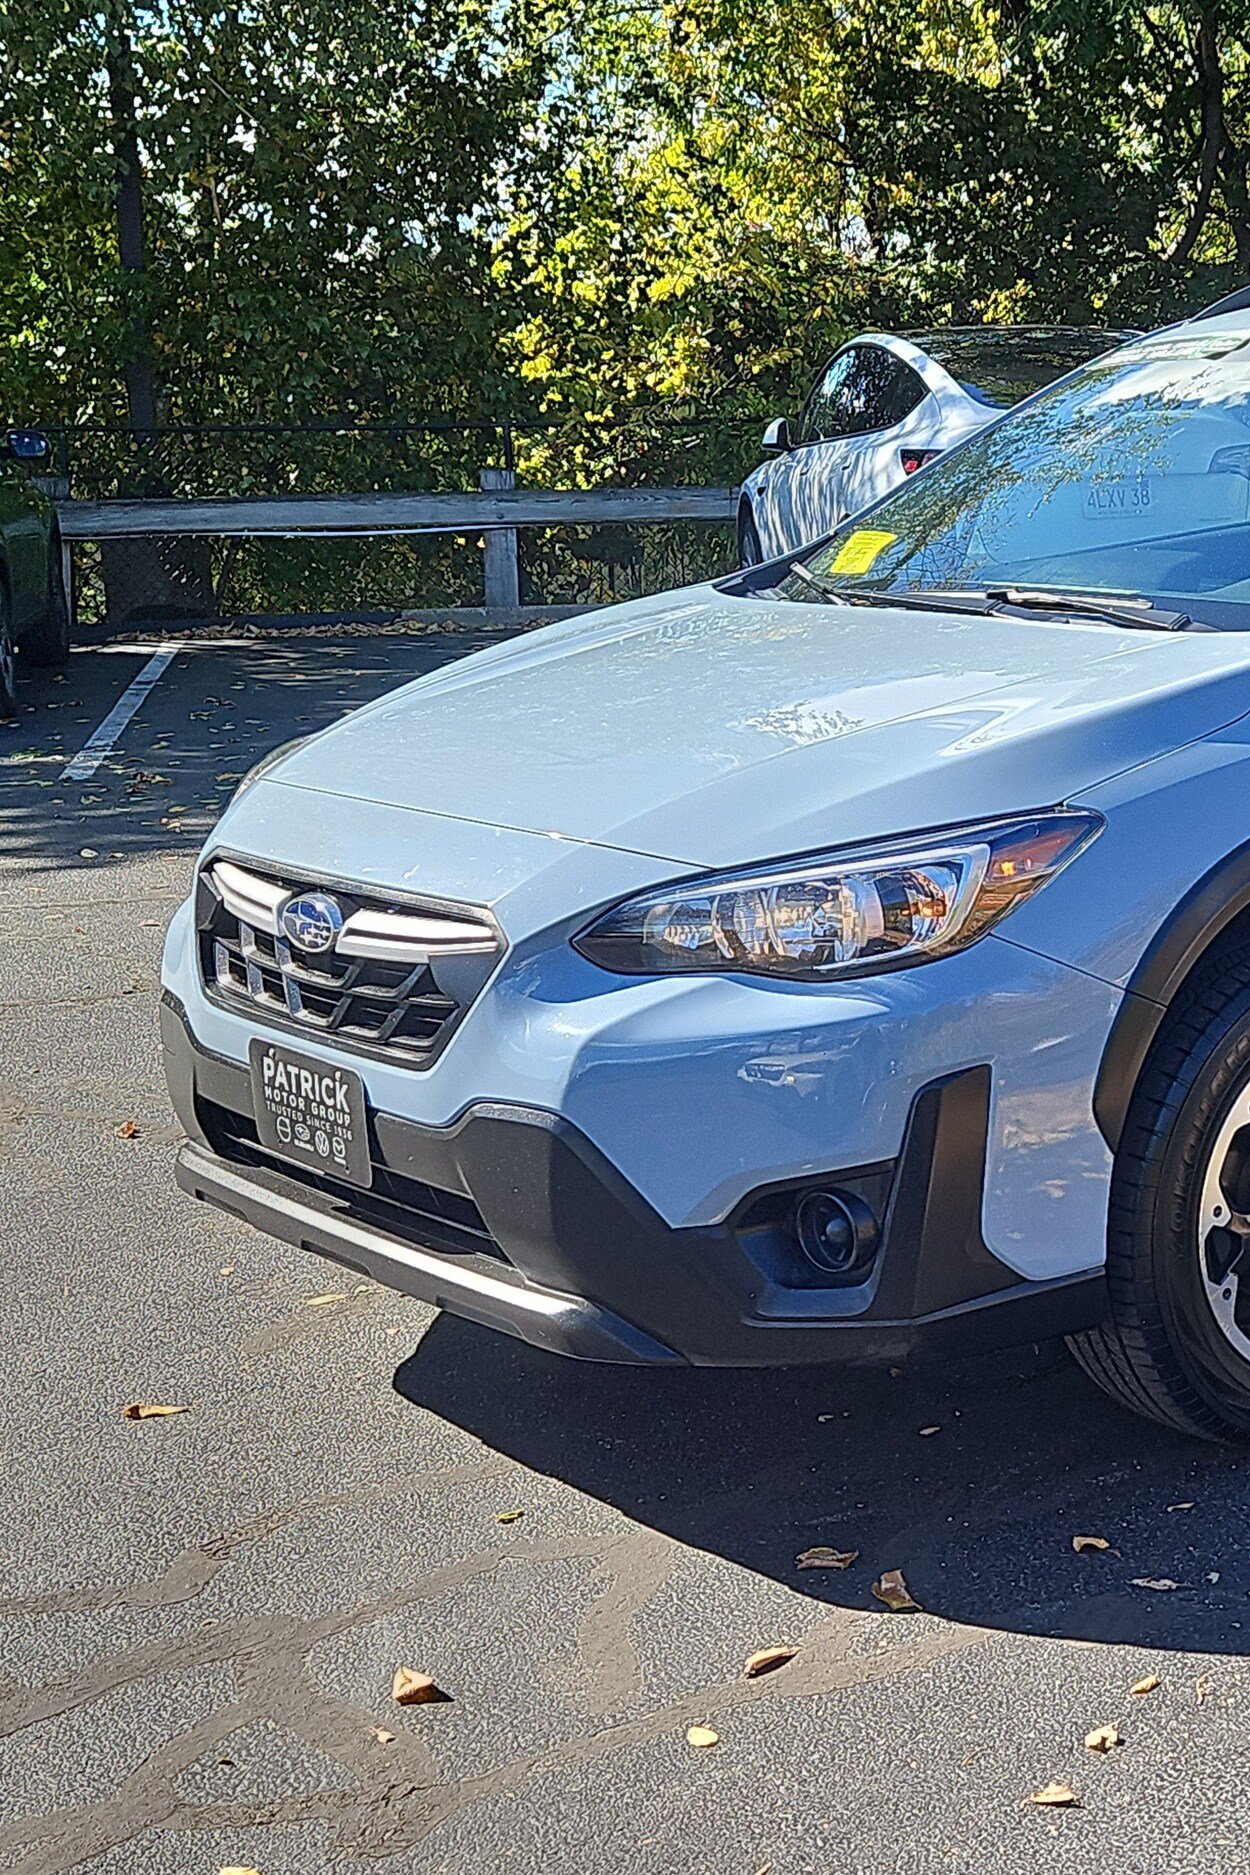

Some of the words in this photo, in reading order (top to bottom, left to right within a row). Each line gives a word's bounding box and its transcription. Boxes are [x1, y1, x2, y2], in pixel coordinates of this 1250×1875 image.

[1131, 488, 1151, 507] 38
[263, 1056, 350, 1113] PATRICK
[264, 1085, 306, 1111] MOTOR
[311, 1101, 351, 1127] GROUP
[265, 1100, 303, 1122] TRUSTED
[306, 1115, 332, 1132] SINCE
